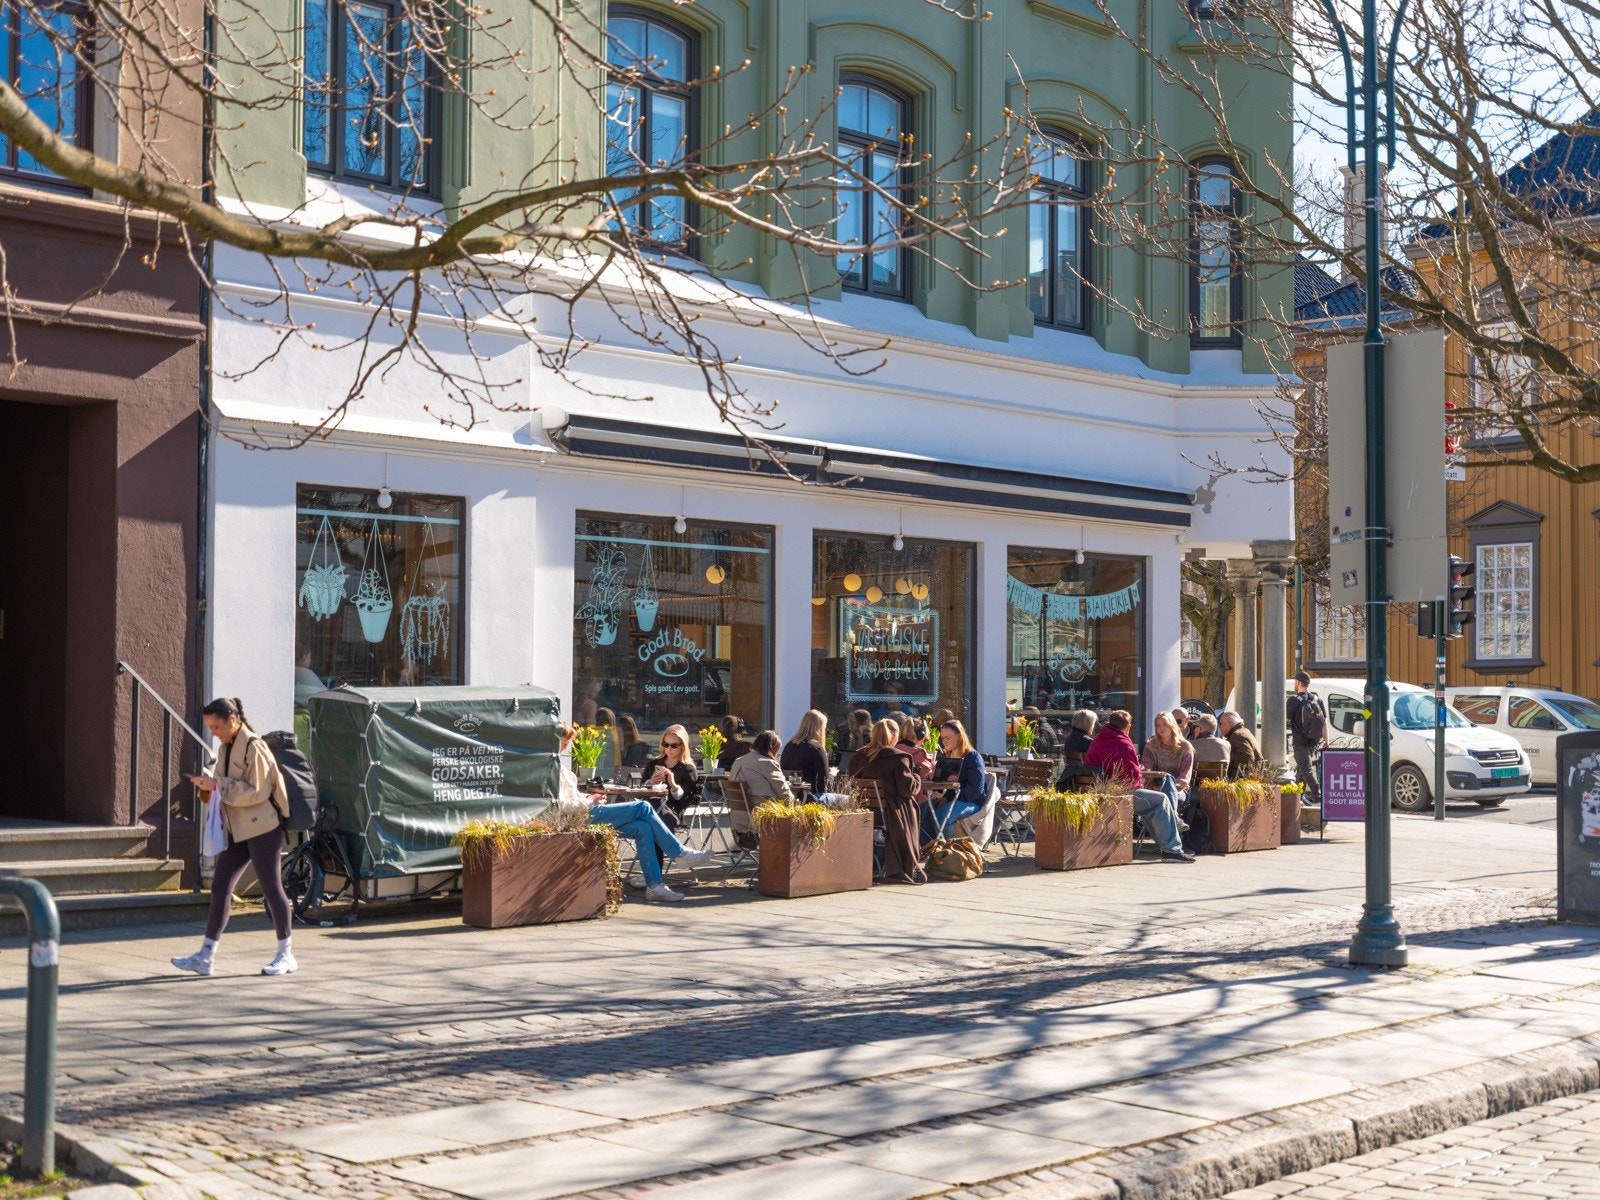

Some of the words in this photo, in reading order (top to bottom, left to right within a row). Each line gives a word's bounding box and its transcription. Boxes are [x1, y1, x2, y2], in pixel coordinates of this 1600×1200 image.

[638, 628, 670, 662] Godt
[673, 628, 707, 663] Brød
[895, 659, 929, 681] BOLLER
[644, 684, 657, 693] Spis
[657, 684, 673, 693] godt.
[674, 684, 684, 692] Lev
[684, 684, 700, 693] godt.
[432, 747, 446, 757] JEG
[447, 747, 457, 756] ER
[459, 745, 471, 756] PÅ
[472, 746, 486, 755] VEI
[486, 745, 504, 755] MED
[432, 757, 459, 767] FERSKE
[459, 755, 504, 766] ØKOLOGISKE
[431, 764, 504, 782] GODSAKER.
[1330, 773, 1363, 790] HEI
[433, 788, 462, 802] HENG
[463, 787, 483, 800] DEG
[1353, 790, 1361, 798] GÅ
